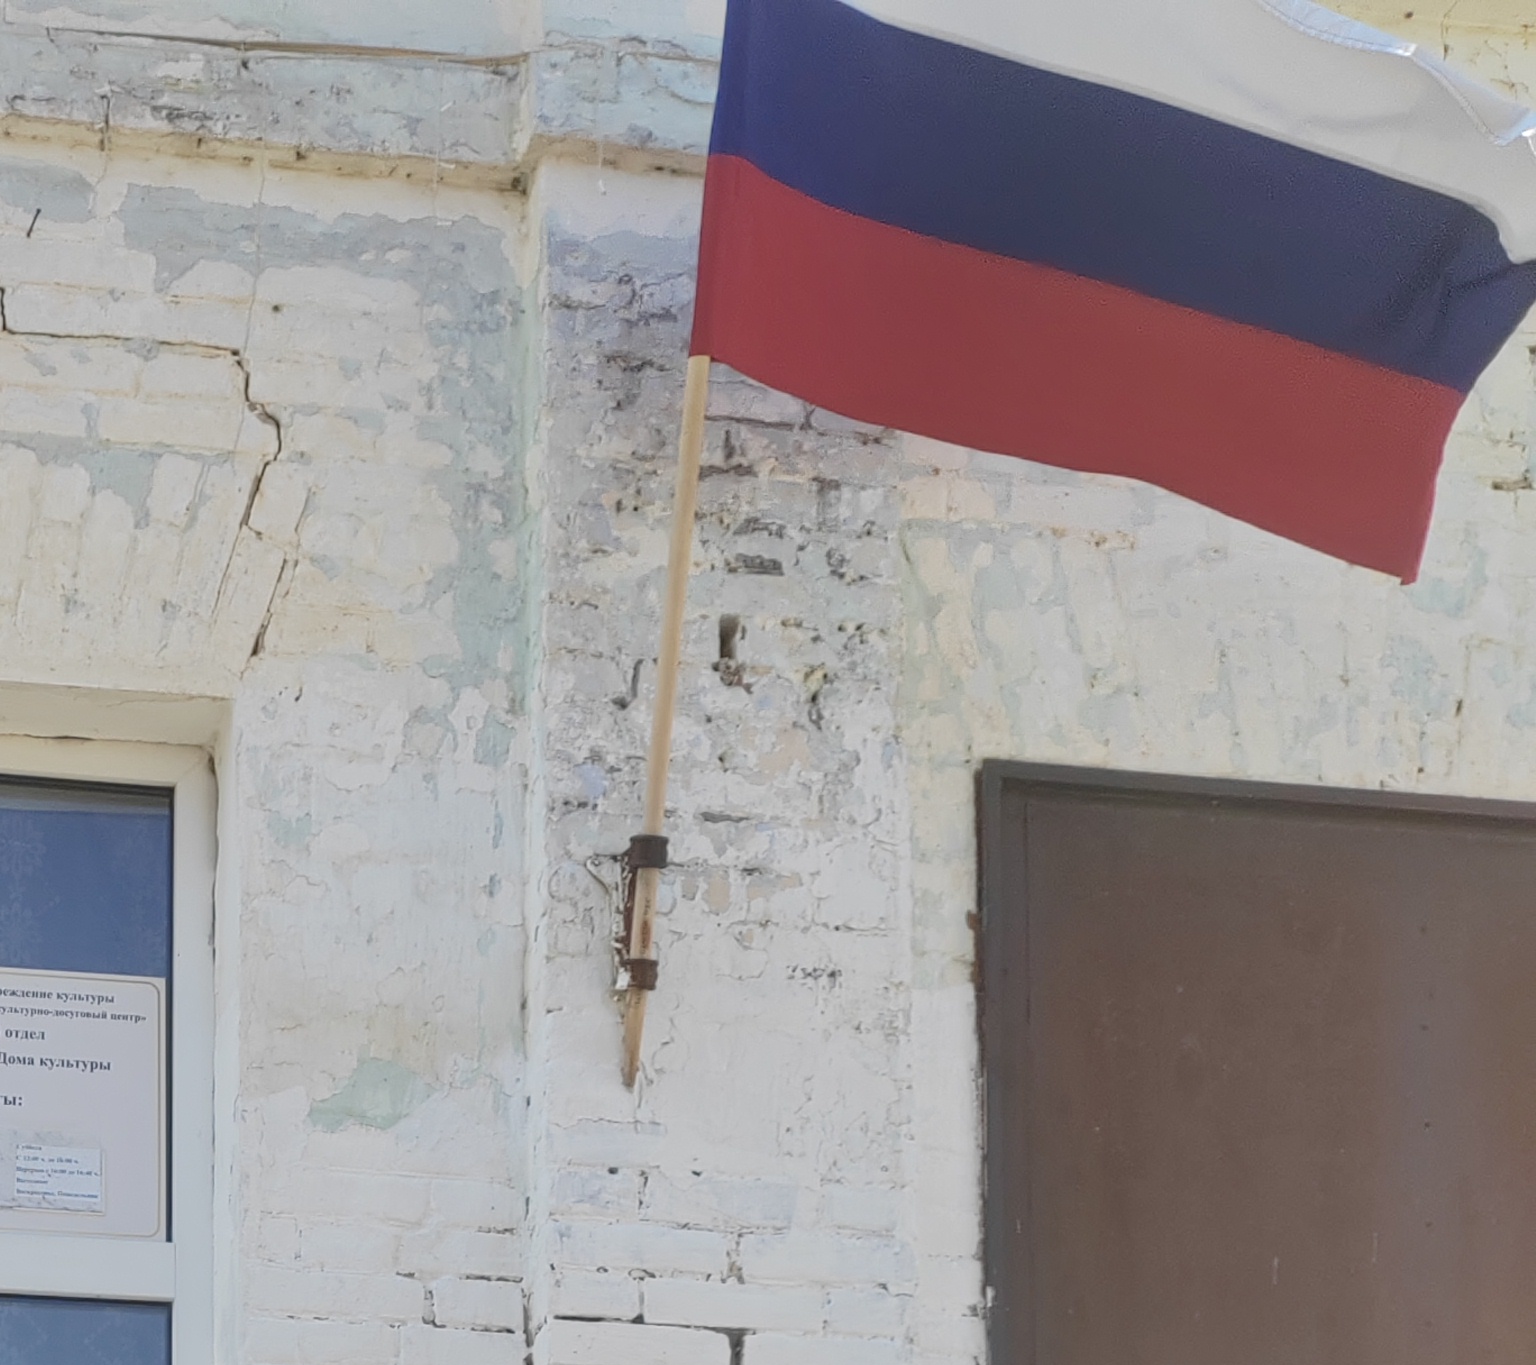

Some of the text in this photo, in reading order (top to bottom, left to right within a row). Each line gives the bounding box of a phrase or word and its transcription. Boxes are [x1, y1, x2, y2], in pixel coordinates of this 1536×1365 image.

[56, 991, 115, 1006] культуры
[5, 1028, 46, 1041] отдел
[39, 1059, 112, 1073] культуры
